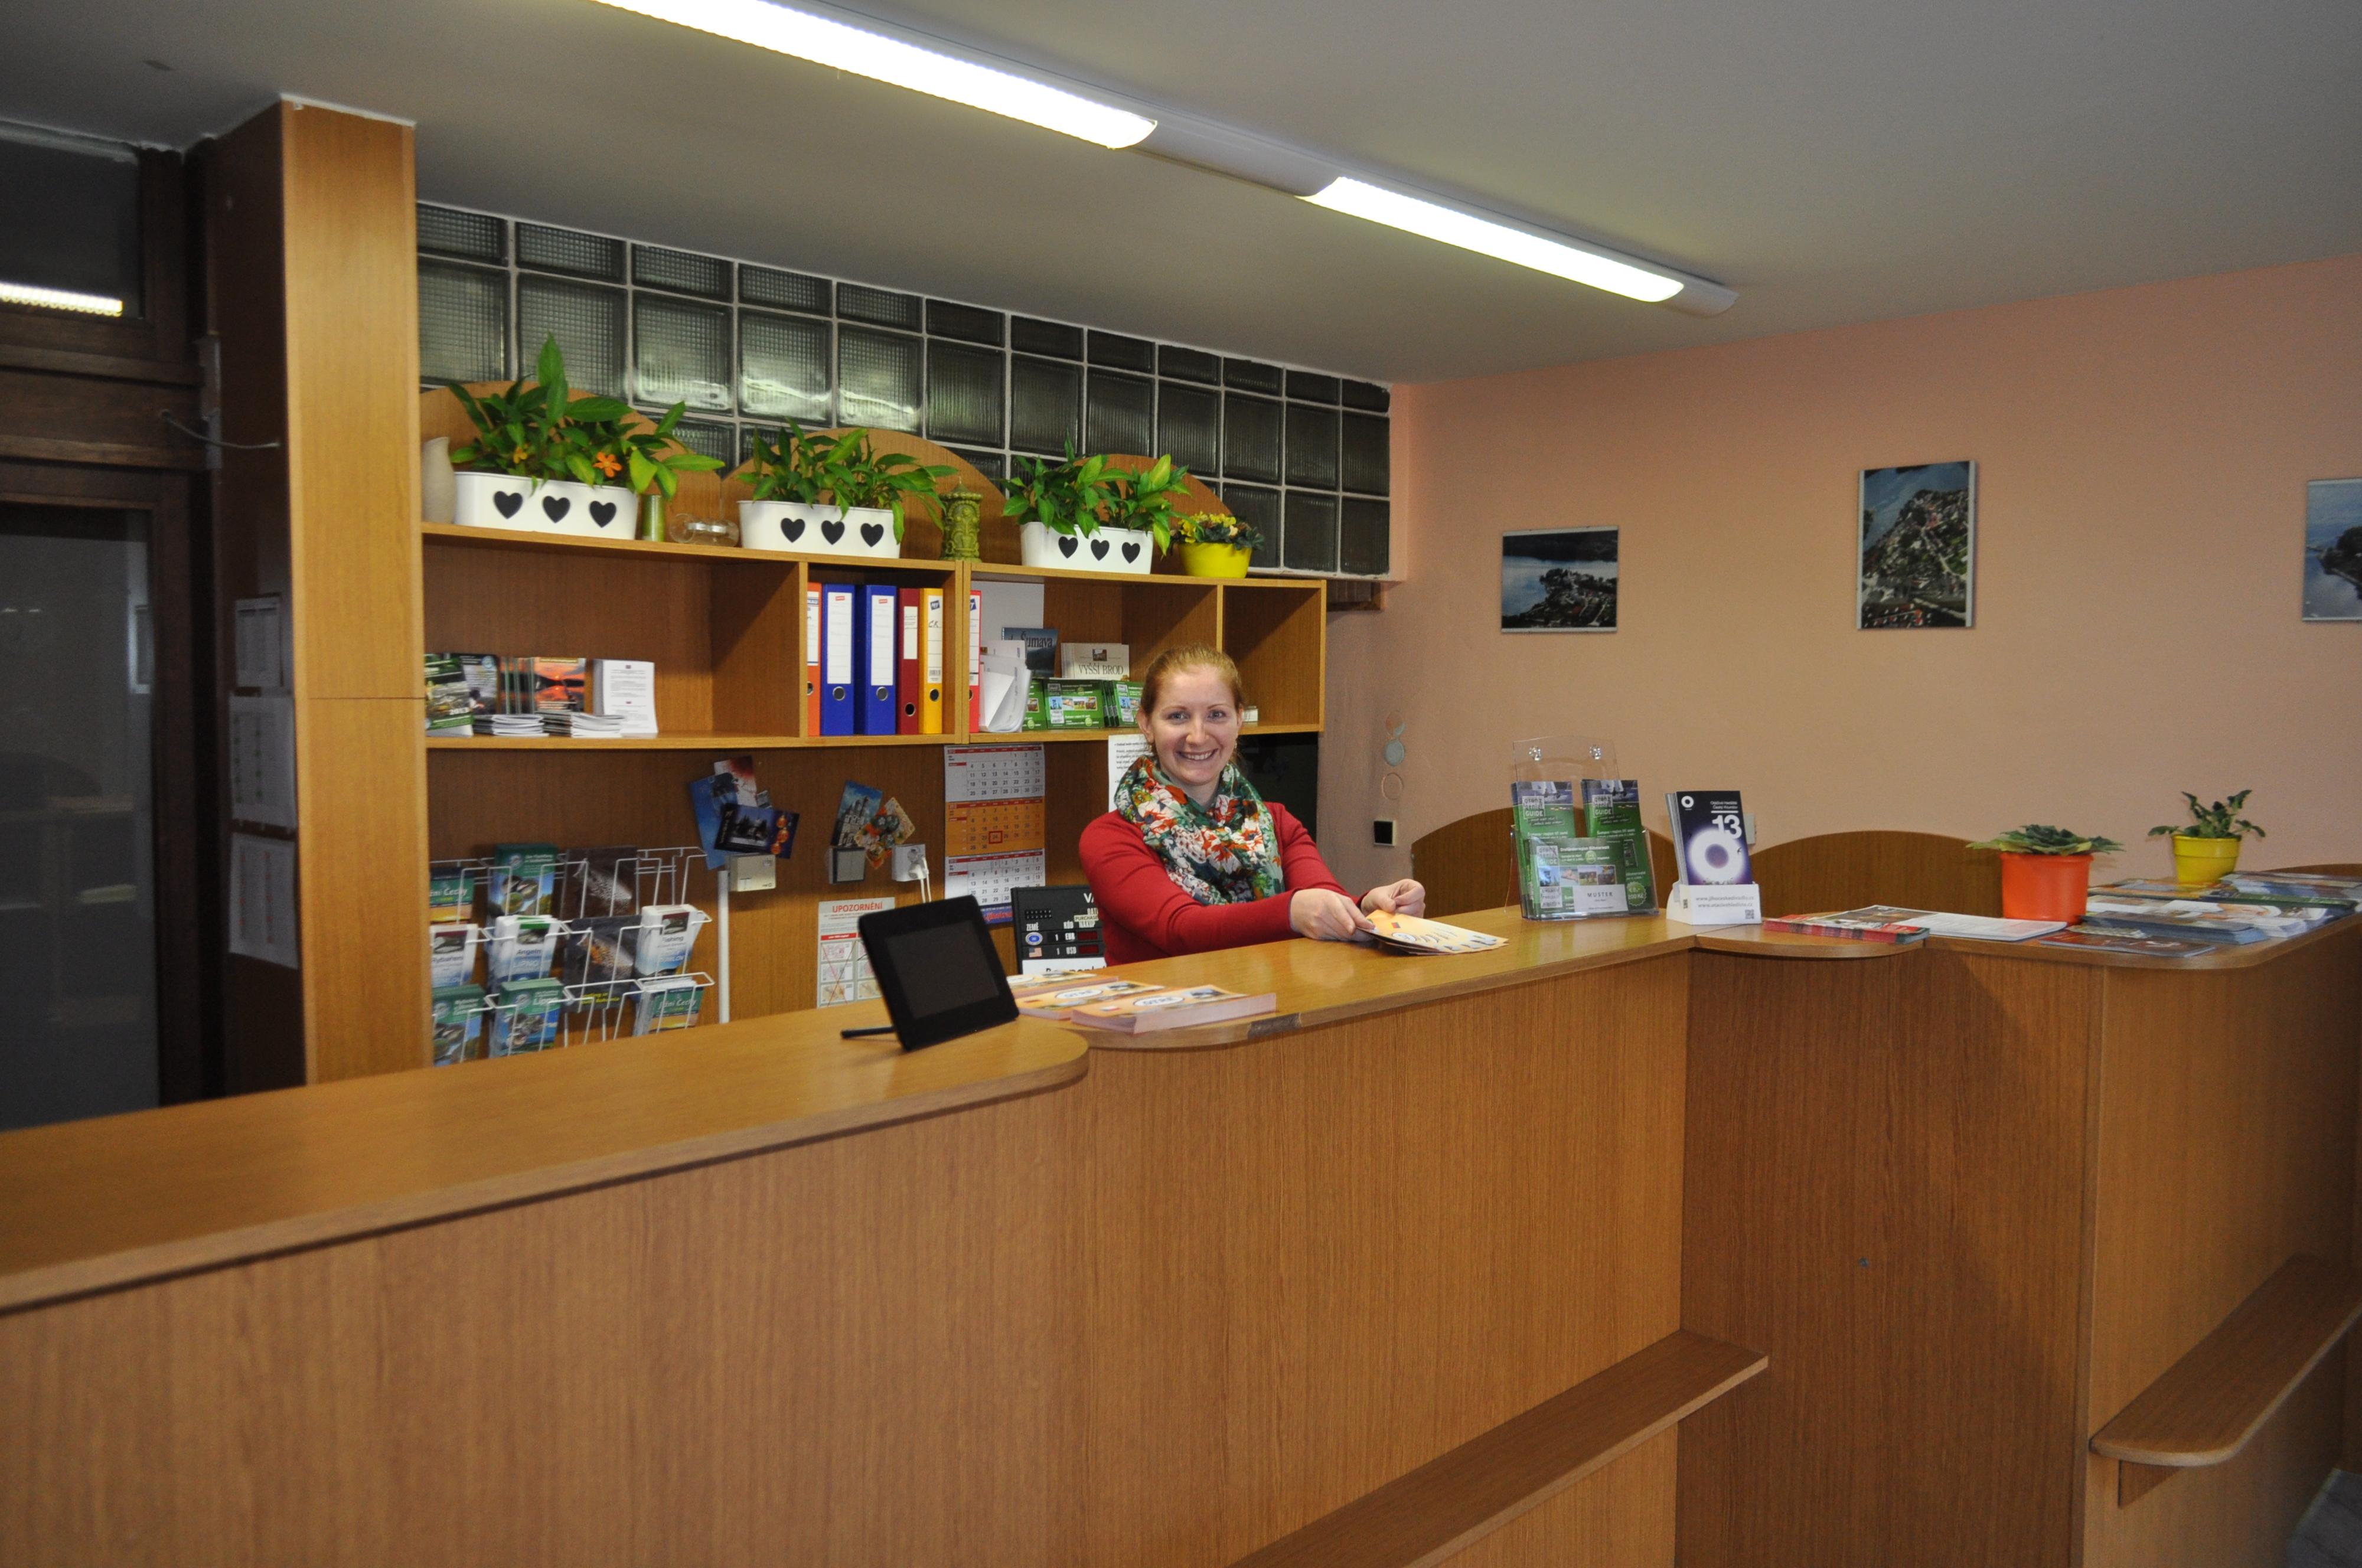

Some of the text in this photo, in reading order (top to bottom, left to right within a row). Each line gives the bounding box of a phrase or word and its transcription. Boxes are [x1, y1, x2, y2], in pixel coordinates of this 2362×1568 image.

[1020, 631, 1053, 648] Šumava
[1079, 663, 1124, 675] VYŠŠÍ BROD
[1712, 815, 1742, 839] 13
[832, 902, 882, 913] UPOZORNĚNÍ
[1065, 932, 1075, 940] EUR
